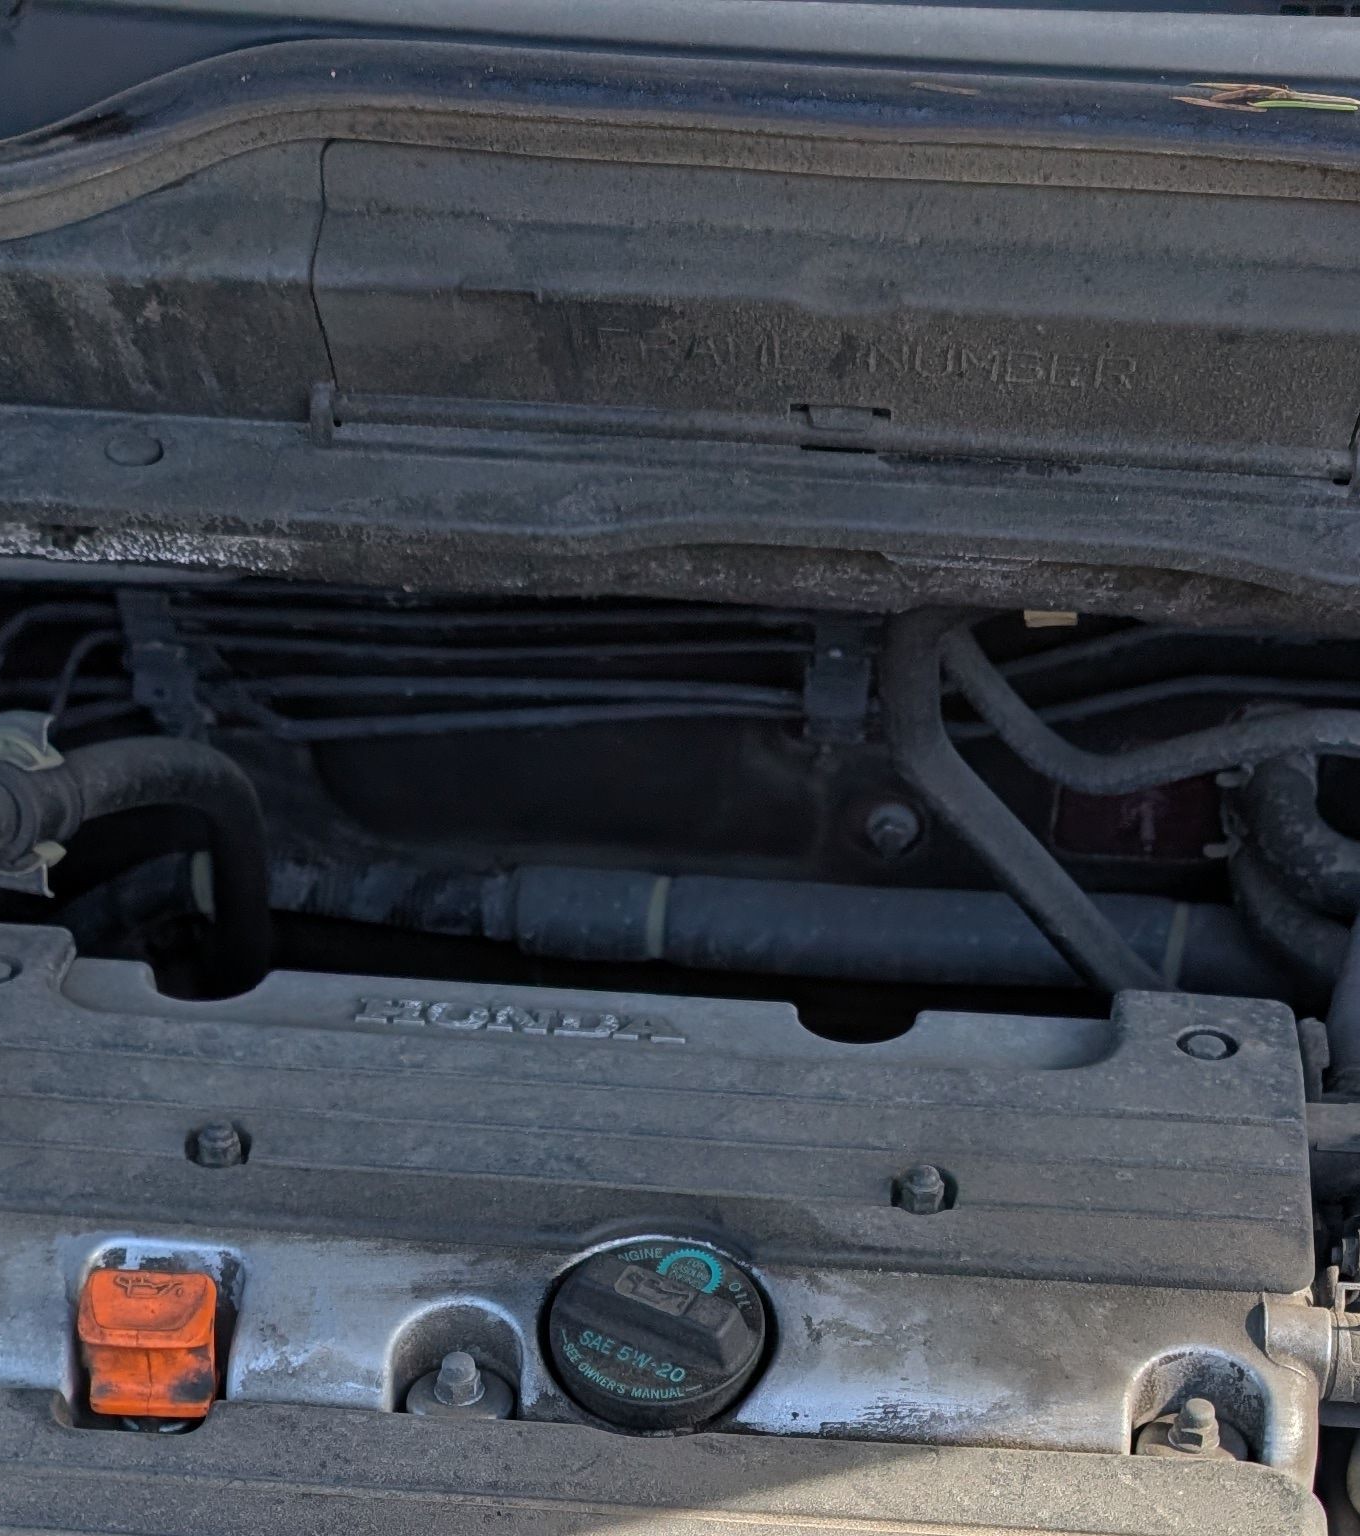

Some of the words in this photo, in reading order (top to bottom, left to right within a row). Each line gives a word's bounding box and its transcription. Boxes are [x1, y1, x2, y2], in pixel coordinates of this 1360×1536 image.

[354, 999, 686, 1044] HONDA
[617, 1247, 664, 1264] NGINE
[563, 1343, 580, 1364] SEE
[578, 1363, 626, 1395] OWNER'S
[631, 1386, 685, 1400] MANUAL
[579, 1330, 616, 1355] SAE
[616, 1346, 686, 1383] 5W-20
